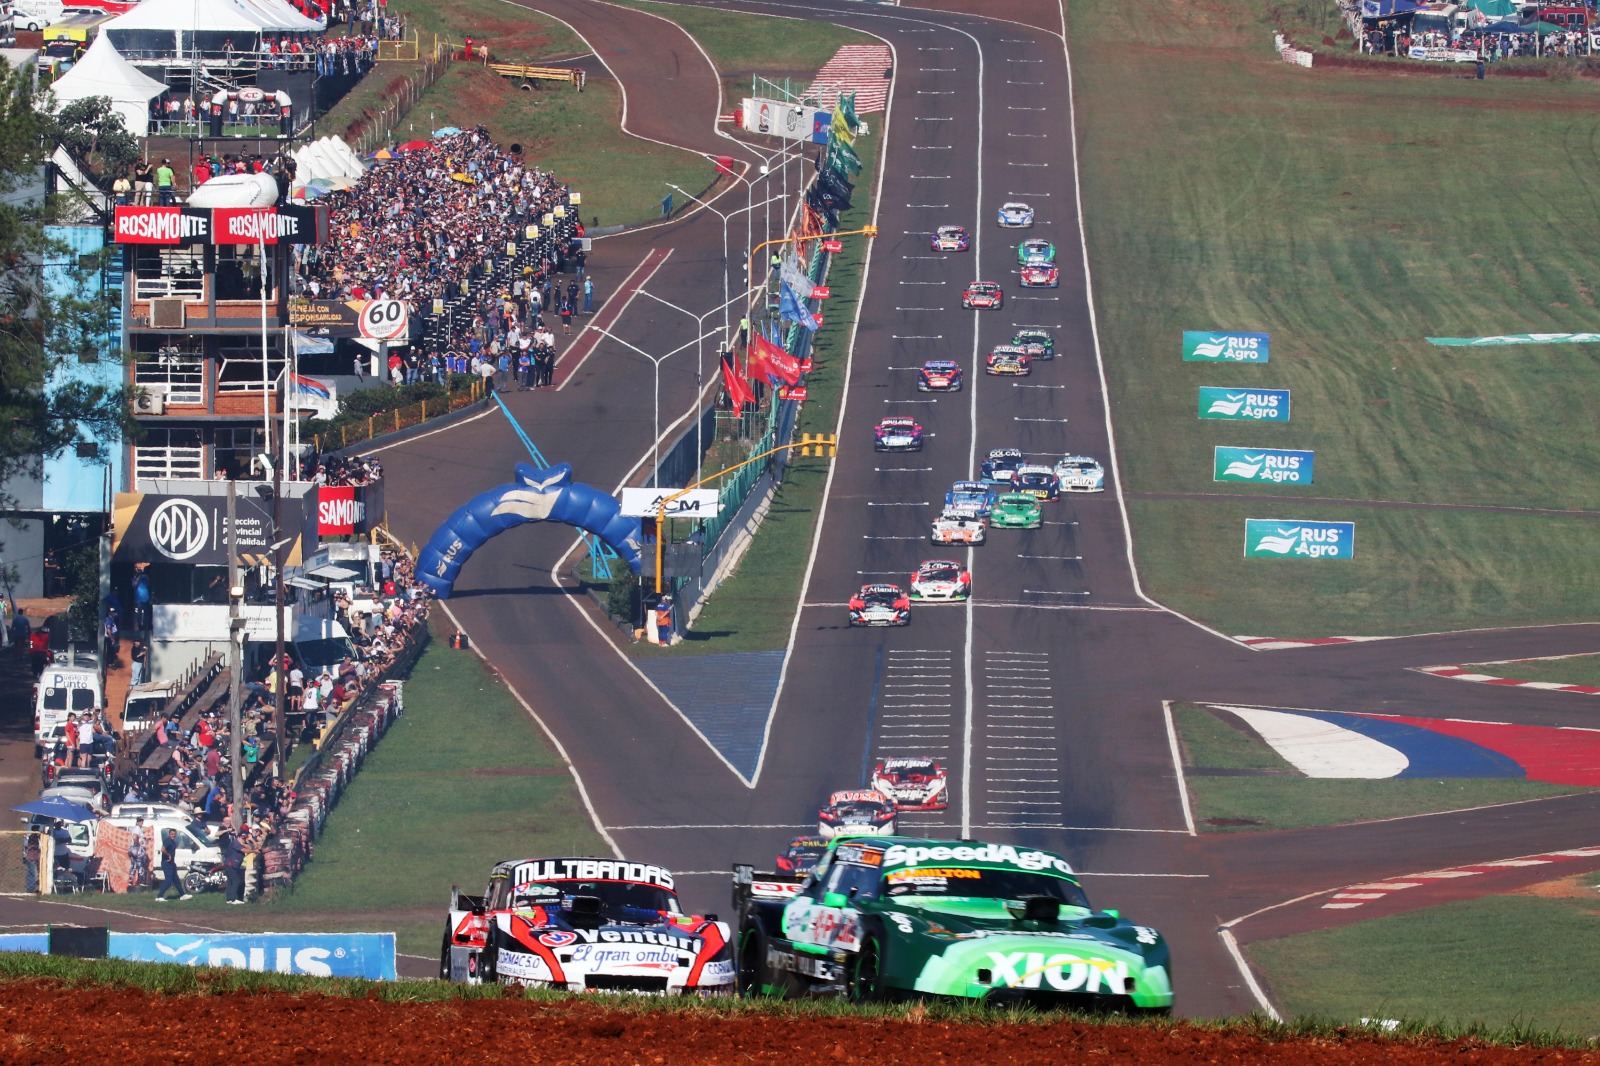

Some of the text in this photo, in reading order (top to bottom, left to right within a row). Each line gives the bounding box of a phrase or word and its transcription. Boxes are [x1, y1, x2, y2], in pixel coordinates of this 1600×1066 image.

[119, 212, 207, 239] ROSAMONTE
[229, 210, 298, 239] ROSAMONTE
[370, 301, 400, 324] 60
[1228, 337, 1258, 348] RUS
[1223, 347, 1258, 360] Agro
[1246, 394, 1278, 407] RUS
[1241, 406, 1278, 418] Agro
[1265, 455, 1299, 469] RUS
[1259, 468, 1299, 482] Agro
[651, 495, 699, 511] ACM
[319, 499, 365, 526] SAMONTE
[223, 517, 260, 526] Dección
[223, 527, 262, 536] Pvincial
[1301, 528, 1339, 543] RUS
[443, 538, 463, 563] RUS
[1295, 541, 1339, 558] Agro
[886, 760, 931, 768] Energizer
[884, 844, 1074, 875] SpeedAgro
[515, 860, 674, 890] MULTIBANDAS
[573, 944, 592, 961] El
[591, 950, 629, 972] gran
[986, 951, 1128, 994] XION
